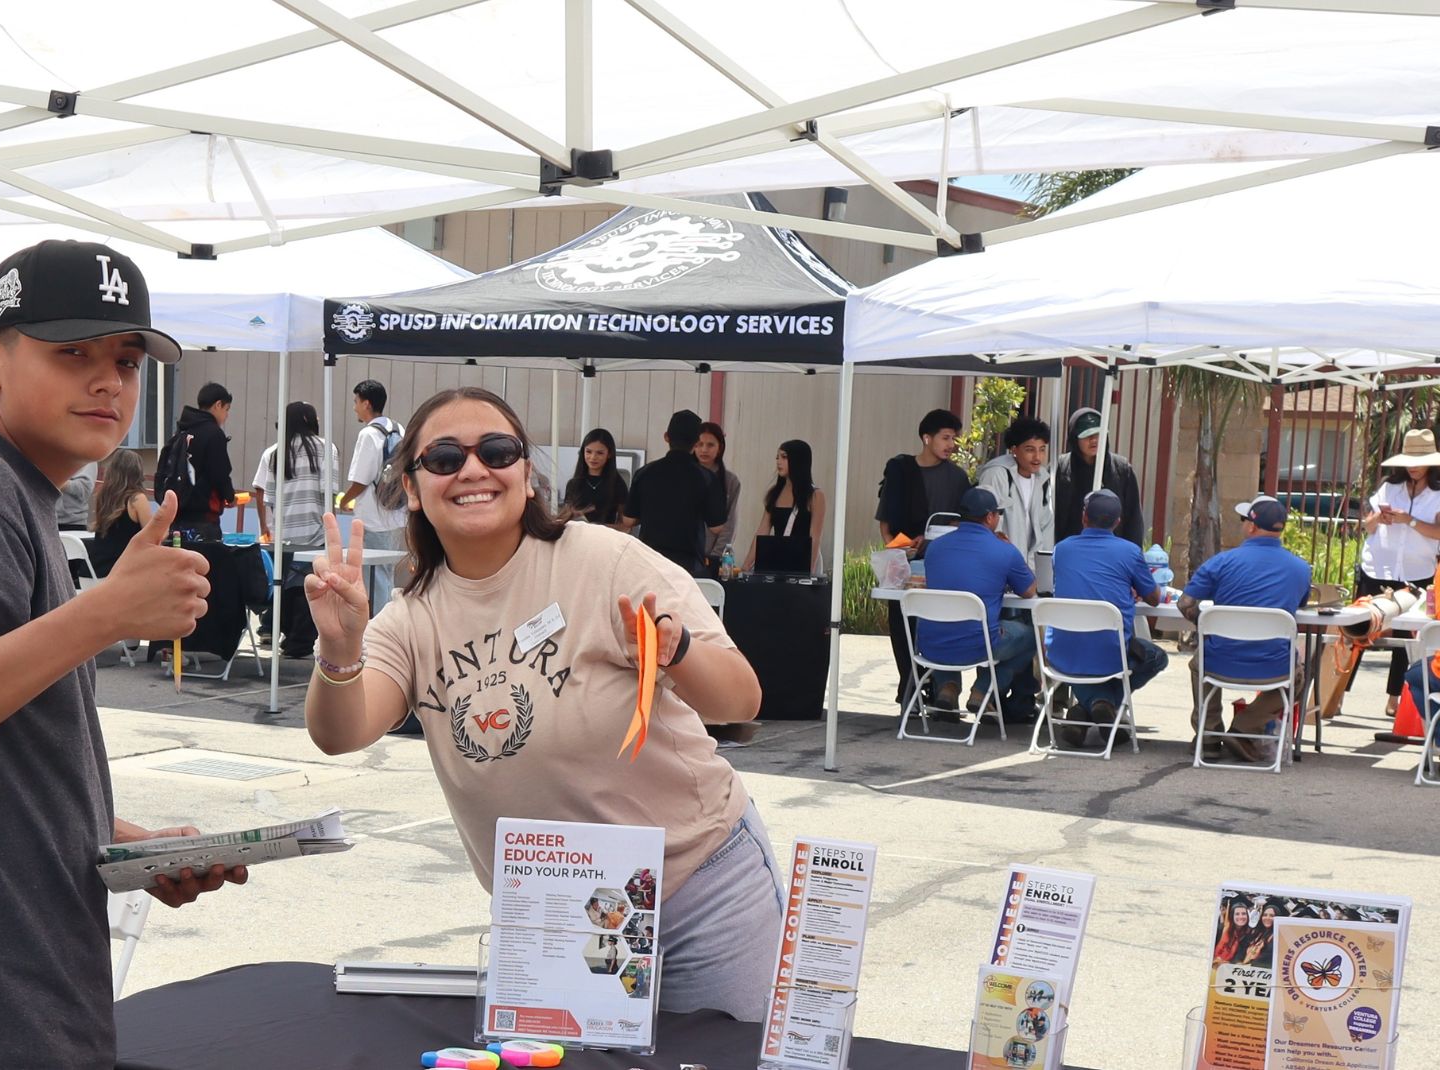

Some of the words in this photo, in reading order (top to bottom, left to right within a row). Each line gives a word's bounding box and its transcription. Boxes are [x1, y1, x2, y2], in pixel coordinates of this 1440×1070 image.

[96, 254, 129, 305] LA
[379, 313, 437, 331] SPUSD
[440, 313, 583, 332] INFORMATION
[587, 313, 730, 333] TECHNOLOGY
[735, 314, 835, 336] SERVICES
[418, 628, 571, 713] VENTURA
[476, 670, 508, 693] 1925
[472, 708, 512, 735] VC
[504, 832, 565, 848] CAREER
[504, 848, 593, 865] EDUCATION
[814, 846, 847, 859] STEPS
[850, 851, 864, 861] TO
[812, 856, 864, 872] ENROLL
[504, 865, 533, 876] FIND
[535, 866, 570, 878] YOUR
[572, 868, 607, 881] PATH.
[1027, 880, 1058, 893] STEPS
[1061, 885, 1075, 895] TO
[1025, 888, 1074, 904] ENROLL
[767, 952, 794, 1049] VENTURA
[785, 849, 810, 942] COLLEGE
[1231, 967, 1255, 978] First
[1281, 949, 1300, 1001] DREAMERS
[1294, 930, 1347, 949] RESOURCE
[1347, 941, 1368, 978] CENTER
[1223, 978, 1237, 993] 2
[1305, 1002, 1338, 1012] VENTURA
[1353, 1010, 1378, 1020] VENTURA
[1288, 1040, 1320, 1048] Dreamers
